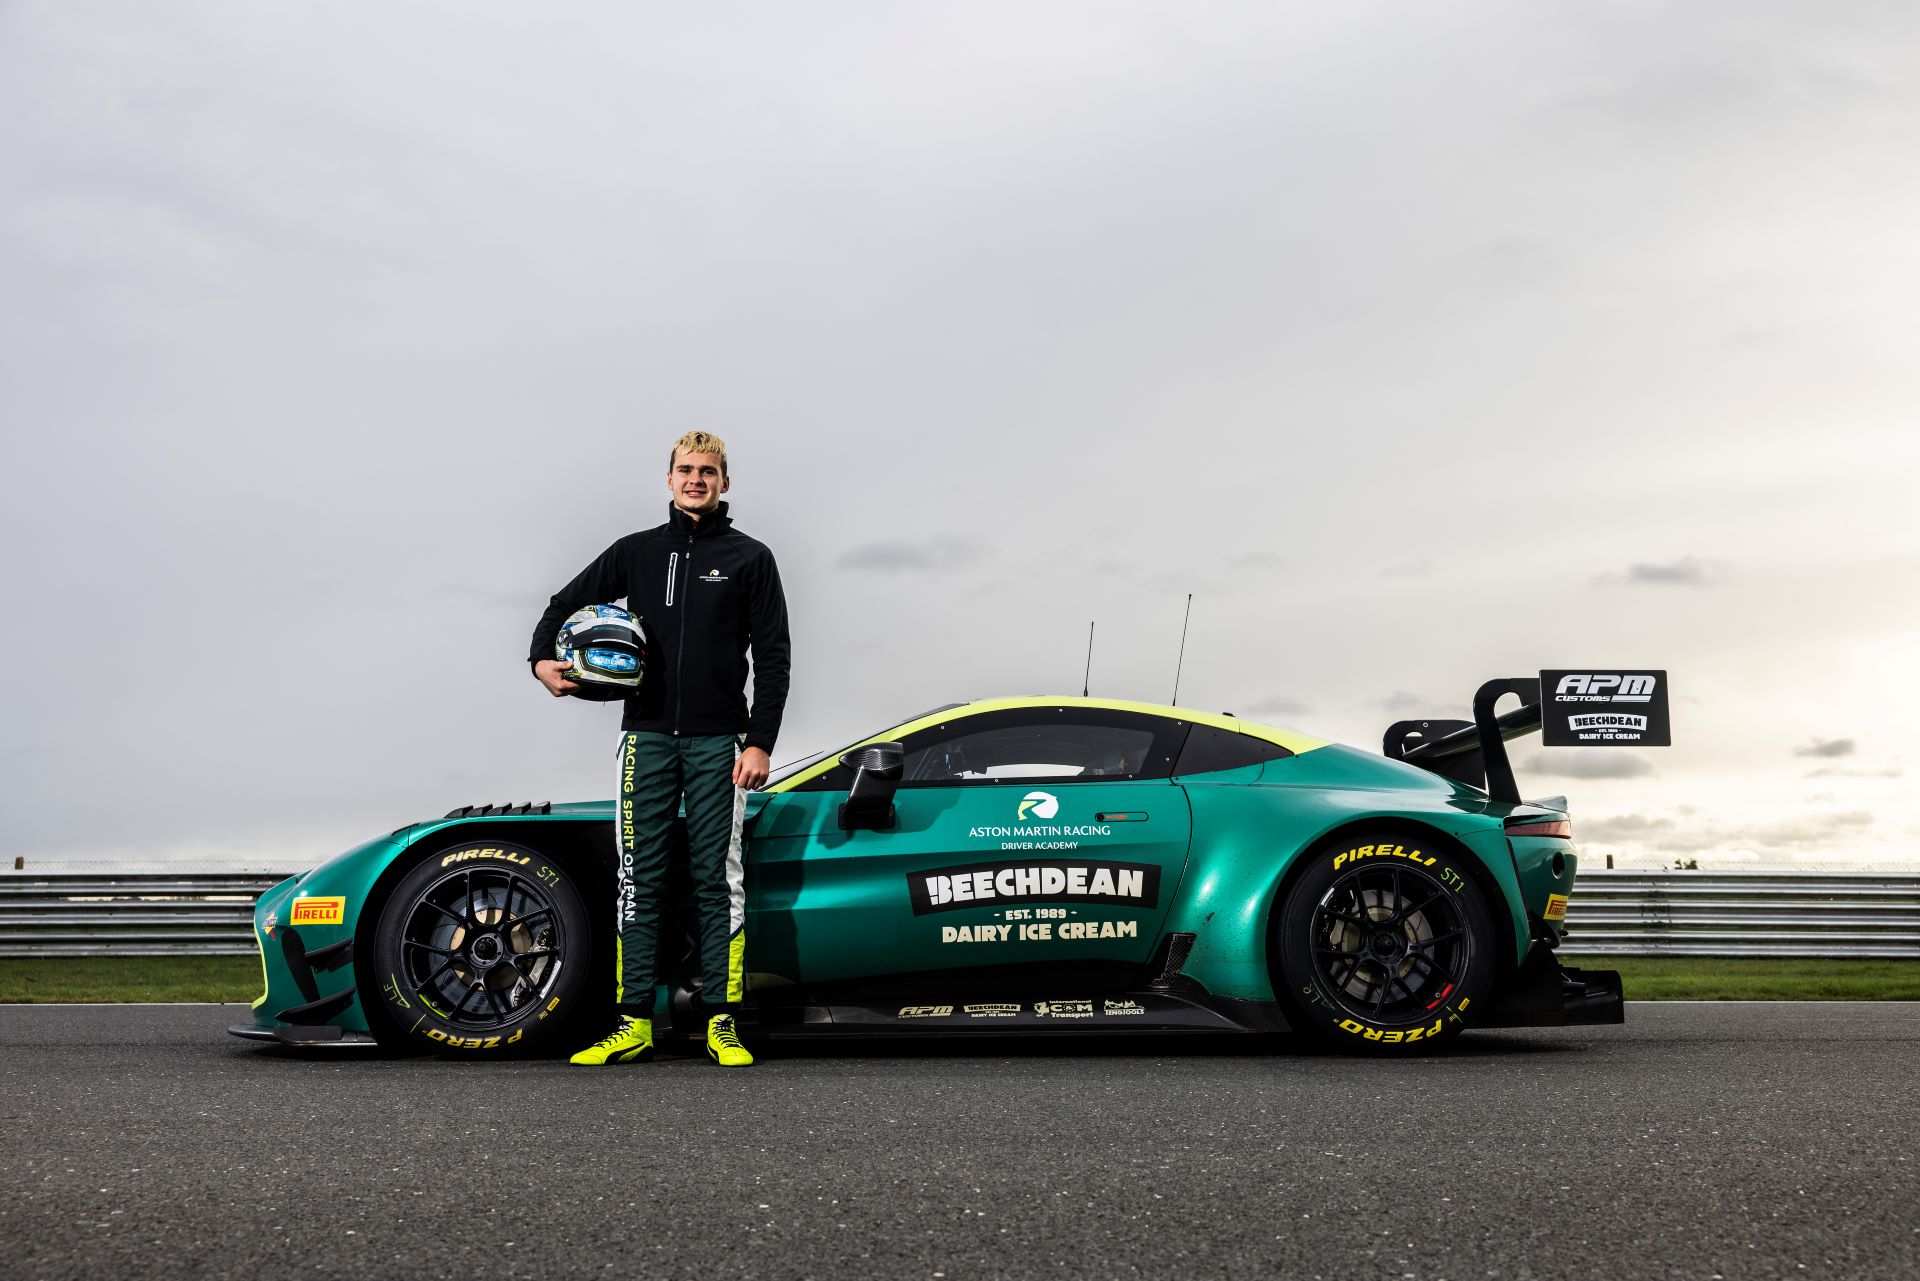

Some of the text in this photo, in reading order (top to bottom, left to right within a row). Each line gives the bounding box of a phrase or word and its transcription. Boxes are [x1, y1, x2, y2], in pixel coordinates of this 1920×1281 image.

[1555, 675, 1656, 694] APM
[1574, 717, 1642, 727] BEECHDEAN
[623, 735, 637, 793] RACING
[623, 800, 635, 850] SPIRIT
[969, 825, 1111, 837] ASTON MARTIN RACING
[1001, 841, 1079, 850] DRIVER ACADEMY
[441, 848, 531, 867] PIRELLI
[623, 853, 634, 876] OF
[1333, 845, 1437, 870] PIRELLI
[925, 867, 1144, 906] BEECHDEAN
[294, 902, 339, 919] PIRELLI
[1005, 908, 1066, 920] EST. 1989
[942, 921, 1138, 943] DAIRY ICE CREAM
[898, 1005, 954, 1016] APM
